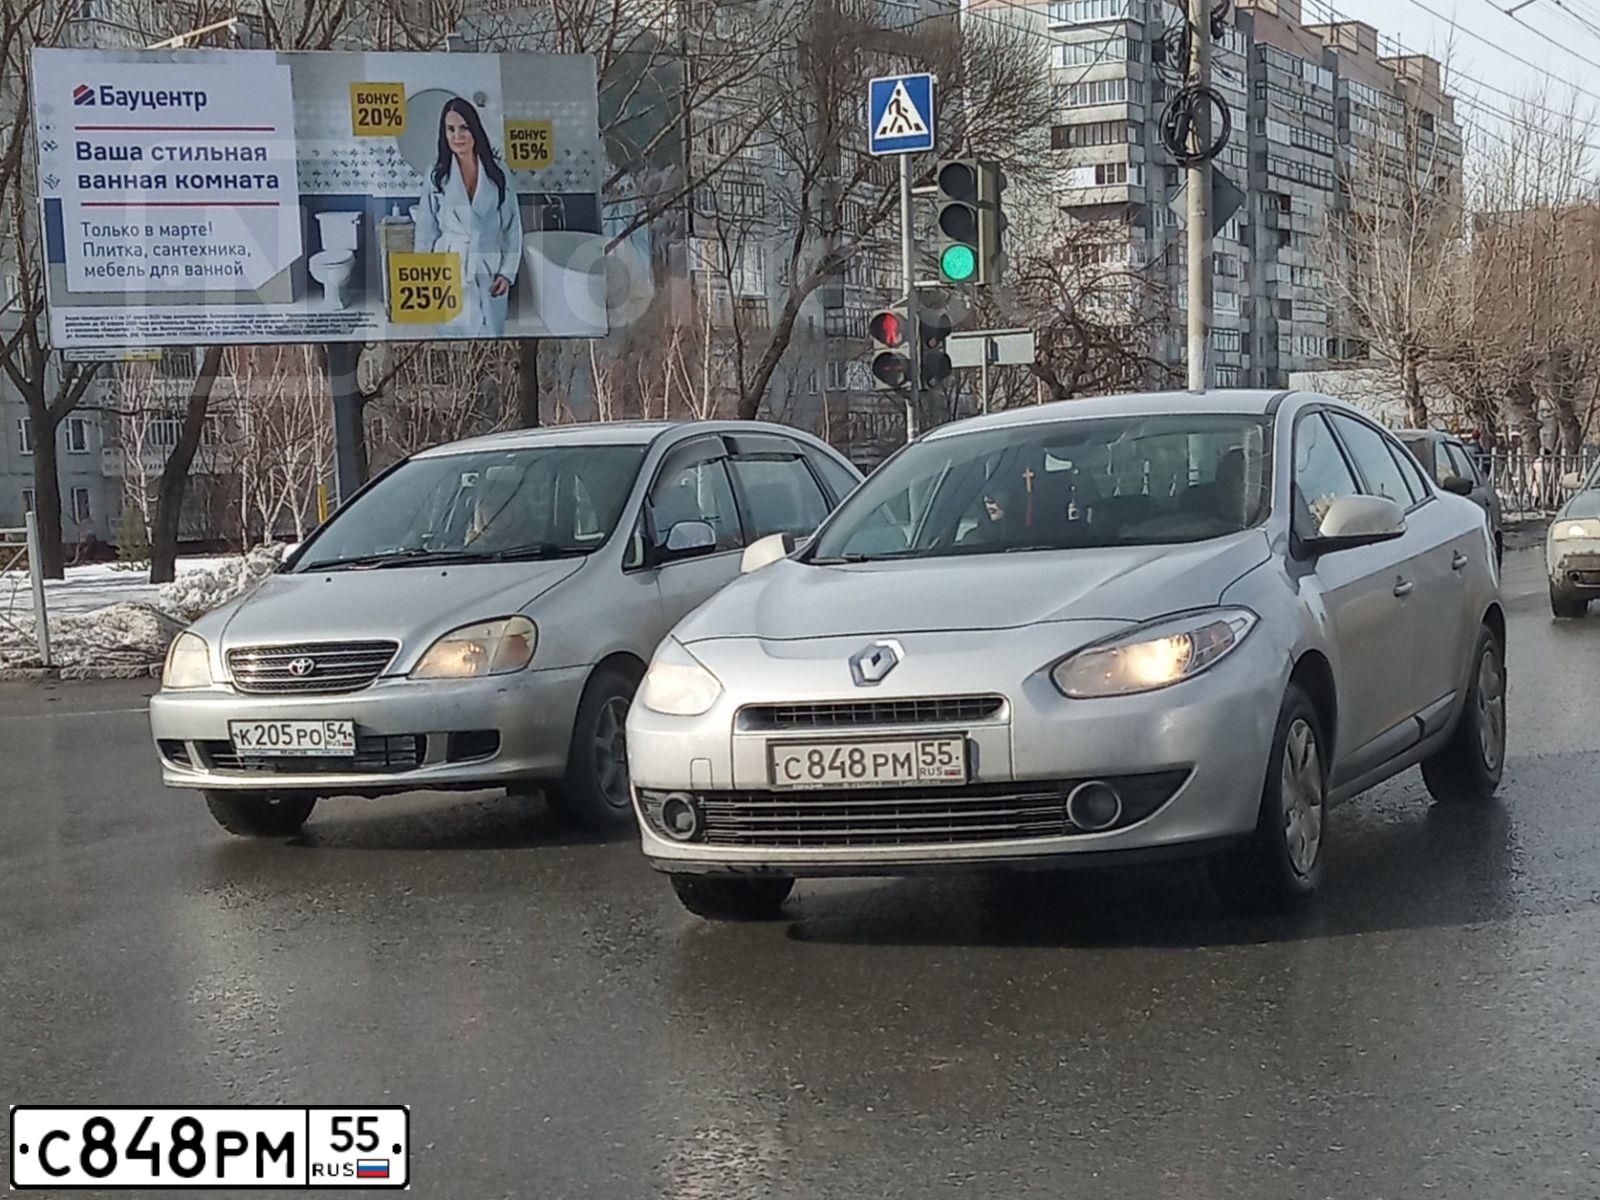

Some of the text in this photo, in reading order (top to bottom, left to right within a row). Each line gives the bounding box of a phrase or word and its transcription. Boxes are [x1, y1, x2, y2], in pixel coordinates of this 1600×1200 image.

[99, 85, 207, 111] Бауцентр
[357, 93, 399, 105] БОНУС
[358, 108, 403, 127] 20%
[509, 129, 548, 141] БОНУС
[76, 141, 267, 161] Ваша стильная
[510, 143, 548, 160] 15%
[78, 173, 279, 189] ванная комната
[81, 222, 213, 241] Только в марте!
[83, 242, 251, 259] Плитка, сантехника,
[85, 260, 244, 279] мебель для ванной
[398, 266, 452, 281] БОНУС
[400, 285, 457, 310] 25%
[326, 722, 348, 740] 54
[921, 741, 952, 766] 55
[919, 766, 943, 777] RUS
